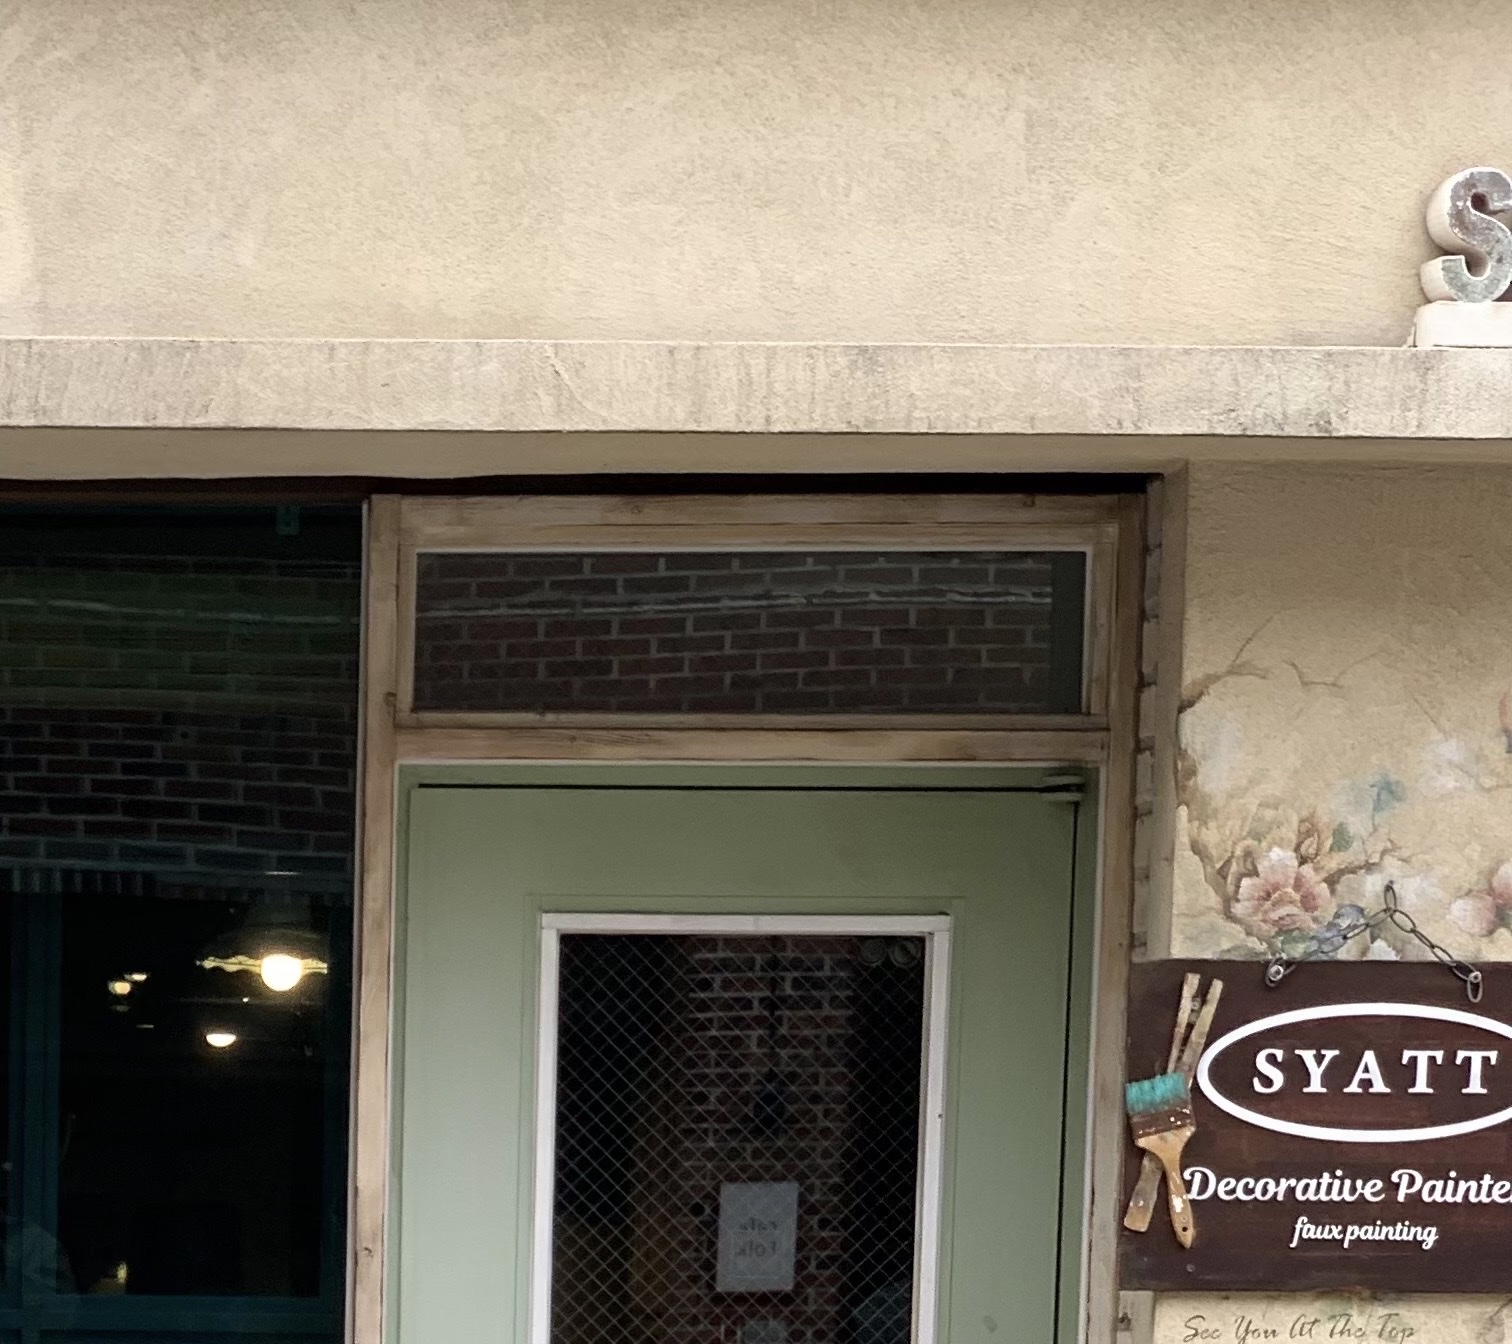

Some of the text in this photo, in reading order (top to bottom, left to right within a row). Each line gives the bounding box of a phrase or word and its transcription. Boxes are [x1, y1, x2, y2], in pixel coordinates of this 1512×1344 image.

[1251, 1047, 1499, 1095] SYATT
[1182, 1166, 1512, 1205] Decorative Painte
[1289, 1215, 1438, 1250] faux painting
